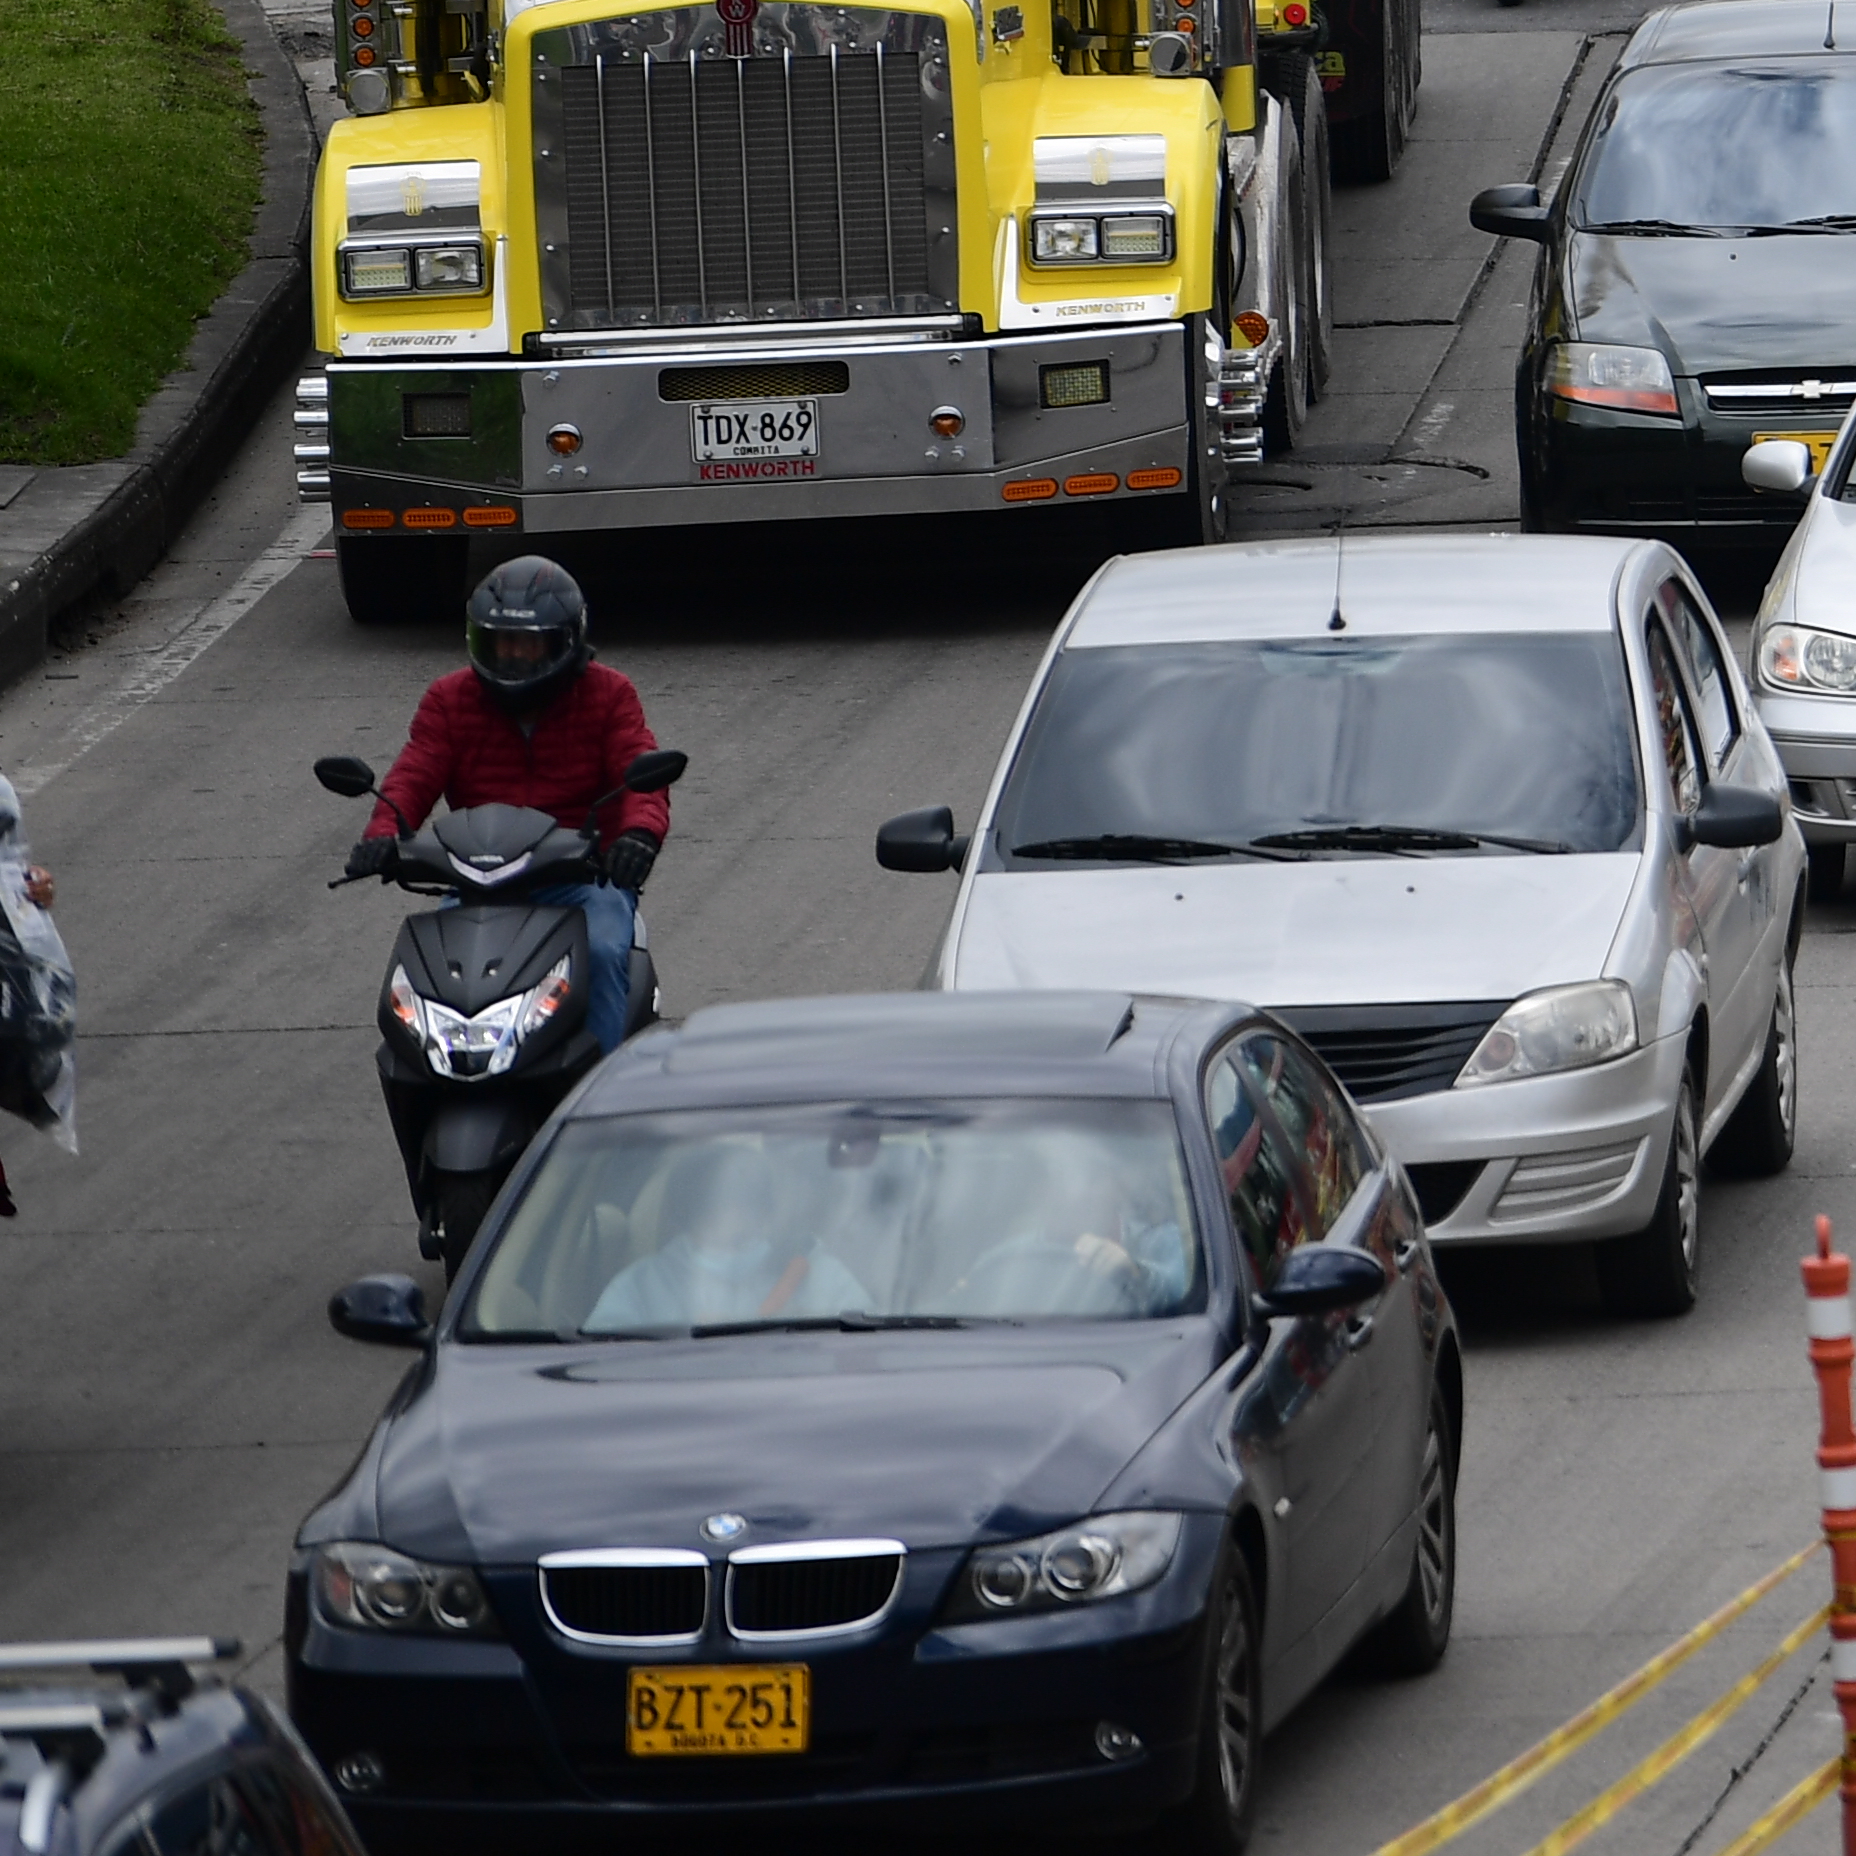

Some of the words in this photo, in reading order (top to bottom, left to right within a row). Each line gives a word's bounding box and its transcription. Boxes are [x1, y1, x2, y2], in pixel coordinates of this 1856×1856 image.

[1056, 301, 1146, 318] KENWORTH
[366, 334, 459, 348] KENWORTH
[698, 412, 749, 446] TDX
[758, 410, 813, 442] 869
[700, 459, 815, 480] KENWORTH
[634, 1687, 702, 1731] BZT
[723, 1682, 797, 1730] 251
